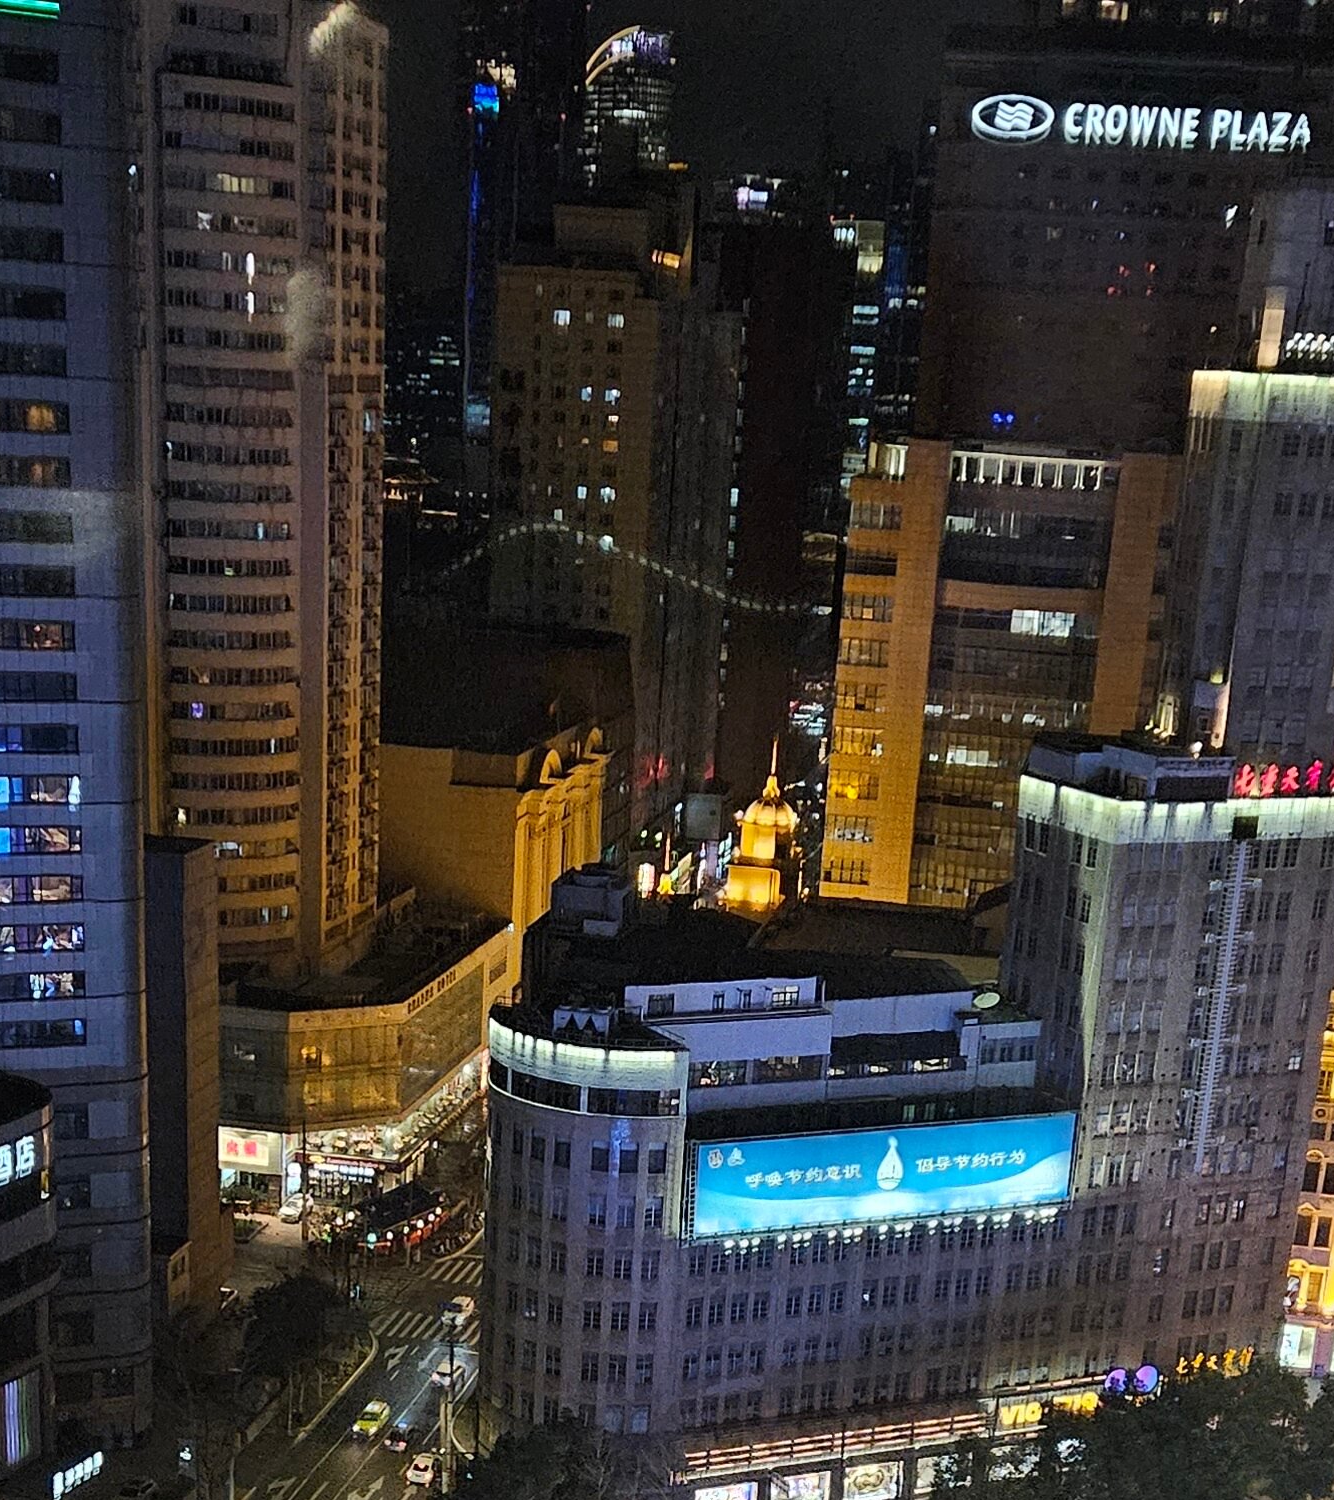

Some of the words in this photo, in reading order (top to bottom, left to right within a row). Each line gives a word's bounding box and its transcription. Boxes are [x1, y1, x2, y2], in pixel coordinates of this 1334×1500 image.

[1063, 102, 1201, 147] CROWNE
[1209, 108, 1312, 152] PLAZA
[914, 1148, 1028, 1174] 倡导节约行为
[744, 1163, 864, 1189] 呼唤节约意识
